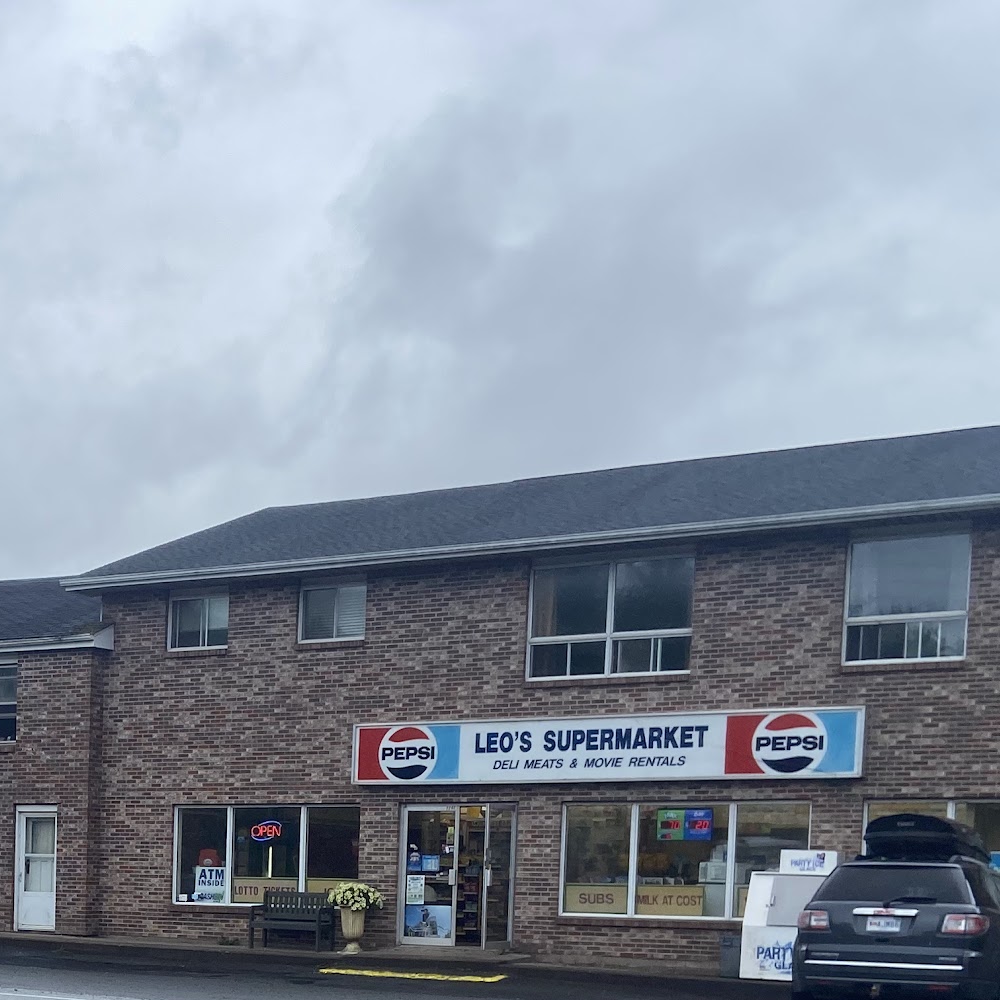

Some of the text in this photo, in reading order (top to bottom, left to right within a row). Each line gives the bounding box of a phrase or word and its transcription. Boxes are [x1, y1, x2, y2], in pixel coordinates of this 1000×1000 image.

[475, 725, 709, 754] LEO'S SUPERMARKET
[755, 735, 824, 751] PEPSI
[381, 746, 435, 760] PEPSI
[492, 755, 686, 770] DELI MEATS & MOVIE RENTALS
[251, 825, 281, 837] OPEN
[199, 868, 225, 880] ATM
[198, 879, 225, 887] INSIDE
[234, 886, 259, 896] LOTTO
[578, 893, 614, 905] SUBS
[635, 895, 703, 906] MILK AT COST
